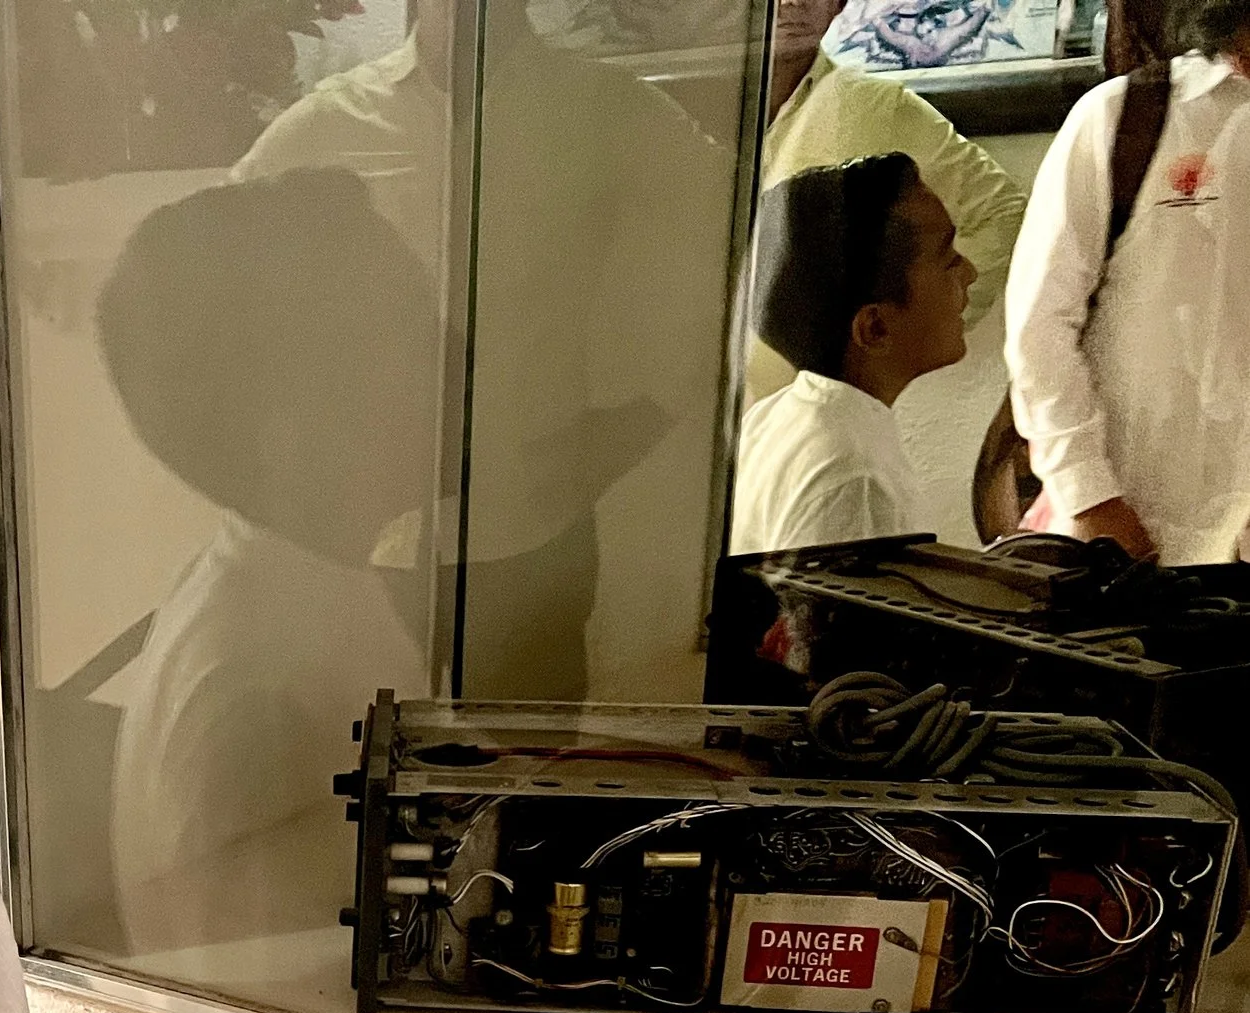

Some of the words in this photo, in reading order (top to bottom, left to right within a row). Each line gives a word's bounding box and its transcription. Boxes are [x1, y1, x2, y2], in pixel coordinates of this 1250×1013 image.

[760, 929, 864, 952] DANGER
[787, 952, 833, 966] HIGH
[766, 965, 850, 983] VOLTAGE
